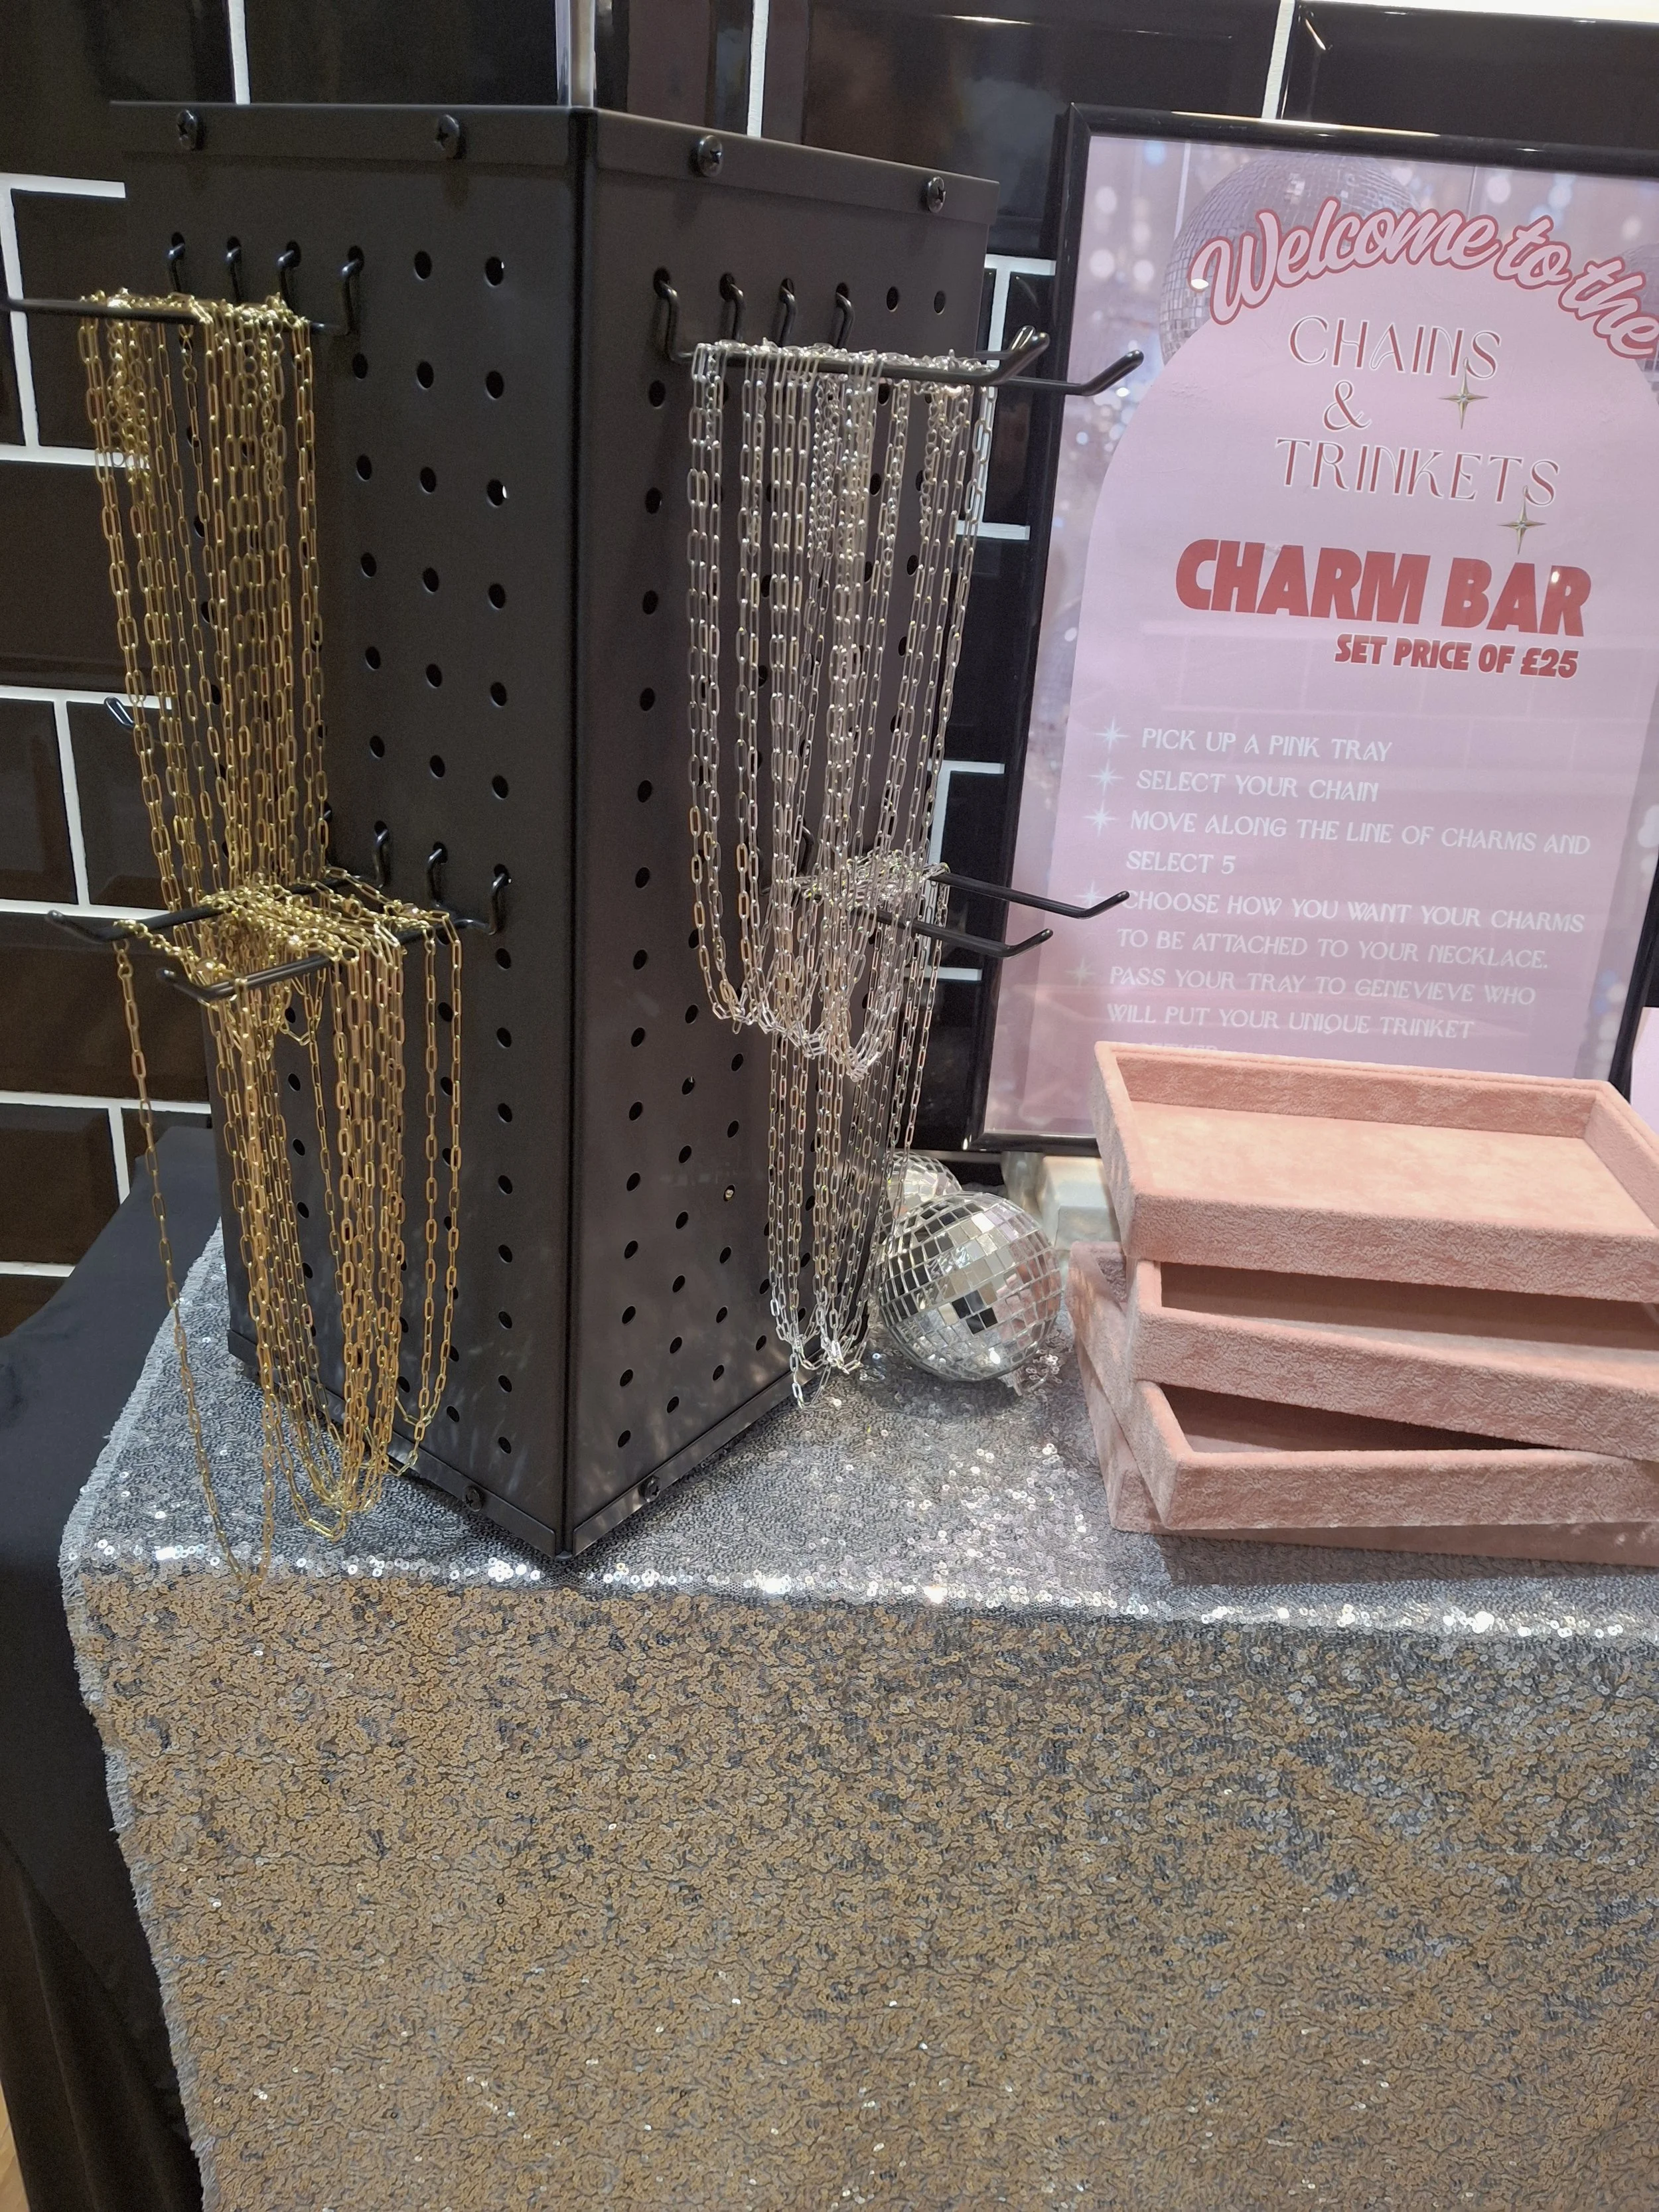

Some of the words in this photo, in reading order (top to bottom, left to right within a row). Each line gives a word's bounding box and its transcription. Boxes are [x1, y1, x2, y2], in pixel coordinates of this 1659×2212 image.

[1189, 196, 1498, 325] Welcome
[1494, 215, 1573, 289] to
[1557, 256, 1659, 359] the
[1289, 315, 1502, 379] CHAINS
[1322, 380, 1372, 431] &
[1275, 437, 1560, 507] TRINKETS
[1176, 538, 1430, 625] CHARM
[1440, 557, 1591, 637] BAR
[1334, 633, 1388, 665] SET
[1394, 637, 1471, 672] PRICE
[1478, 643, 1517, 674] OF
[1520, 648, 1579, 680] £25
[1141, 728, 1196, 751] PICK
[1206, 732, 1236, 753] UP
[1244, 734, 1260, 754] A
[1269, 735, 1320, 757] PINK
[1331, 738, 1392, 761] TRAY
[1136, 769, 1226, 793] SELECT
[1235, 774, 1299, 798] YOUR
[1309, 779, 1379, 802] CHAIN
[1130, 810, 1197, 832] MOVE
[1204, 815, 1287, 837] ALONG
[1296, 819, 1340, 840] THE
[1346, 822, 1394, 844] LINE
[1402, 826, 1434, 846] OF
[1441, 828, 1537, 851] CHARMS
[1544, 834, 1590, 854] AND
[1126, 850, 1214, 873] SELECT
[1221, 855, 1236, 874] 5
[1122, 890, 1220, 914] CHOOSE
[1227, 895, 1282, 916] HOW
[1291, 898, 1338, 919] YOU
[1347, 901, 1412, 923] WANT
[1421, 905, 1481, 927] YOUR
[1491, 910, 1585, 932] CHARMS
[1118, 929, 1148, 948] TO
[1156, 930, 1185, 950] BE
[1192, 933, 1308, 956] ATTACHED
[1317, 938, 1348, 958] TO
[1358, 940, 1418, 962] YOUR
[1428, 944, 1548, 969] NECKLACE.
[1110, 966, 1165, 986] PASS
[1175, 969, 1236, 990] YOUR
[1248, 973, 1306, 993] TRAY
[1315, 976, 1346, 995] TO
[1355, 979, 1475, 1001] GENEVIEVE
[1484, 984, 1536, 1004] WHO
[1107, 1003, 1156, 1023] WILL
[1165, 1007, 1210, 1025] PUT
[1219, 1009, 1280, 1029] YOUR
[1289, 1012, 1370, 1035] UNIQUE
[1380, 1015, 1474, 1039] TRINKET
